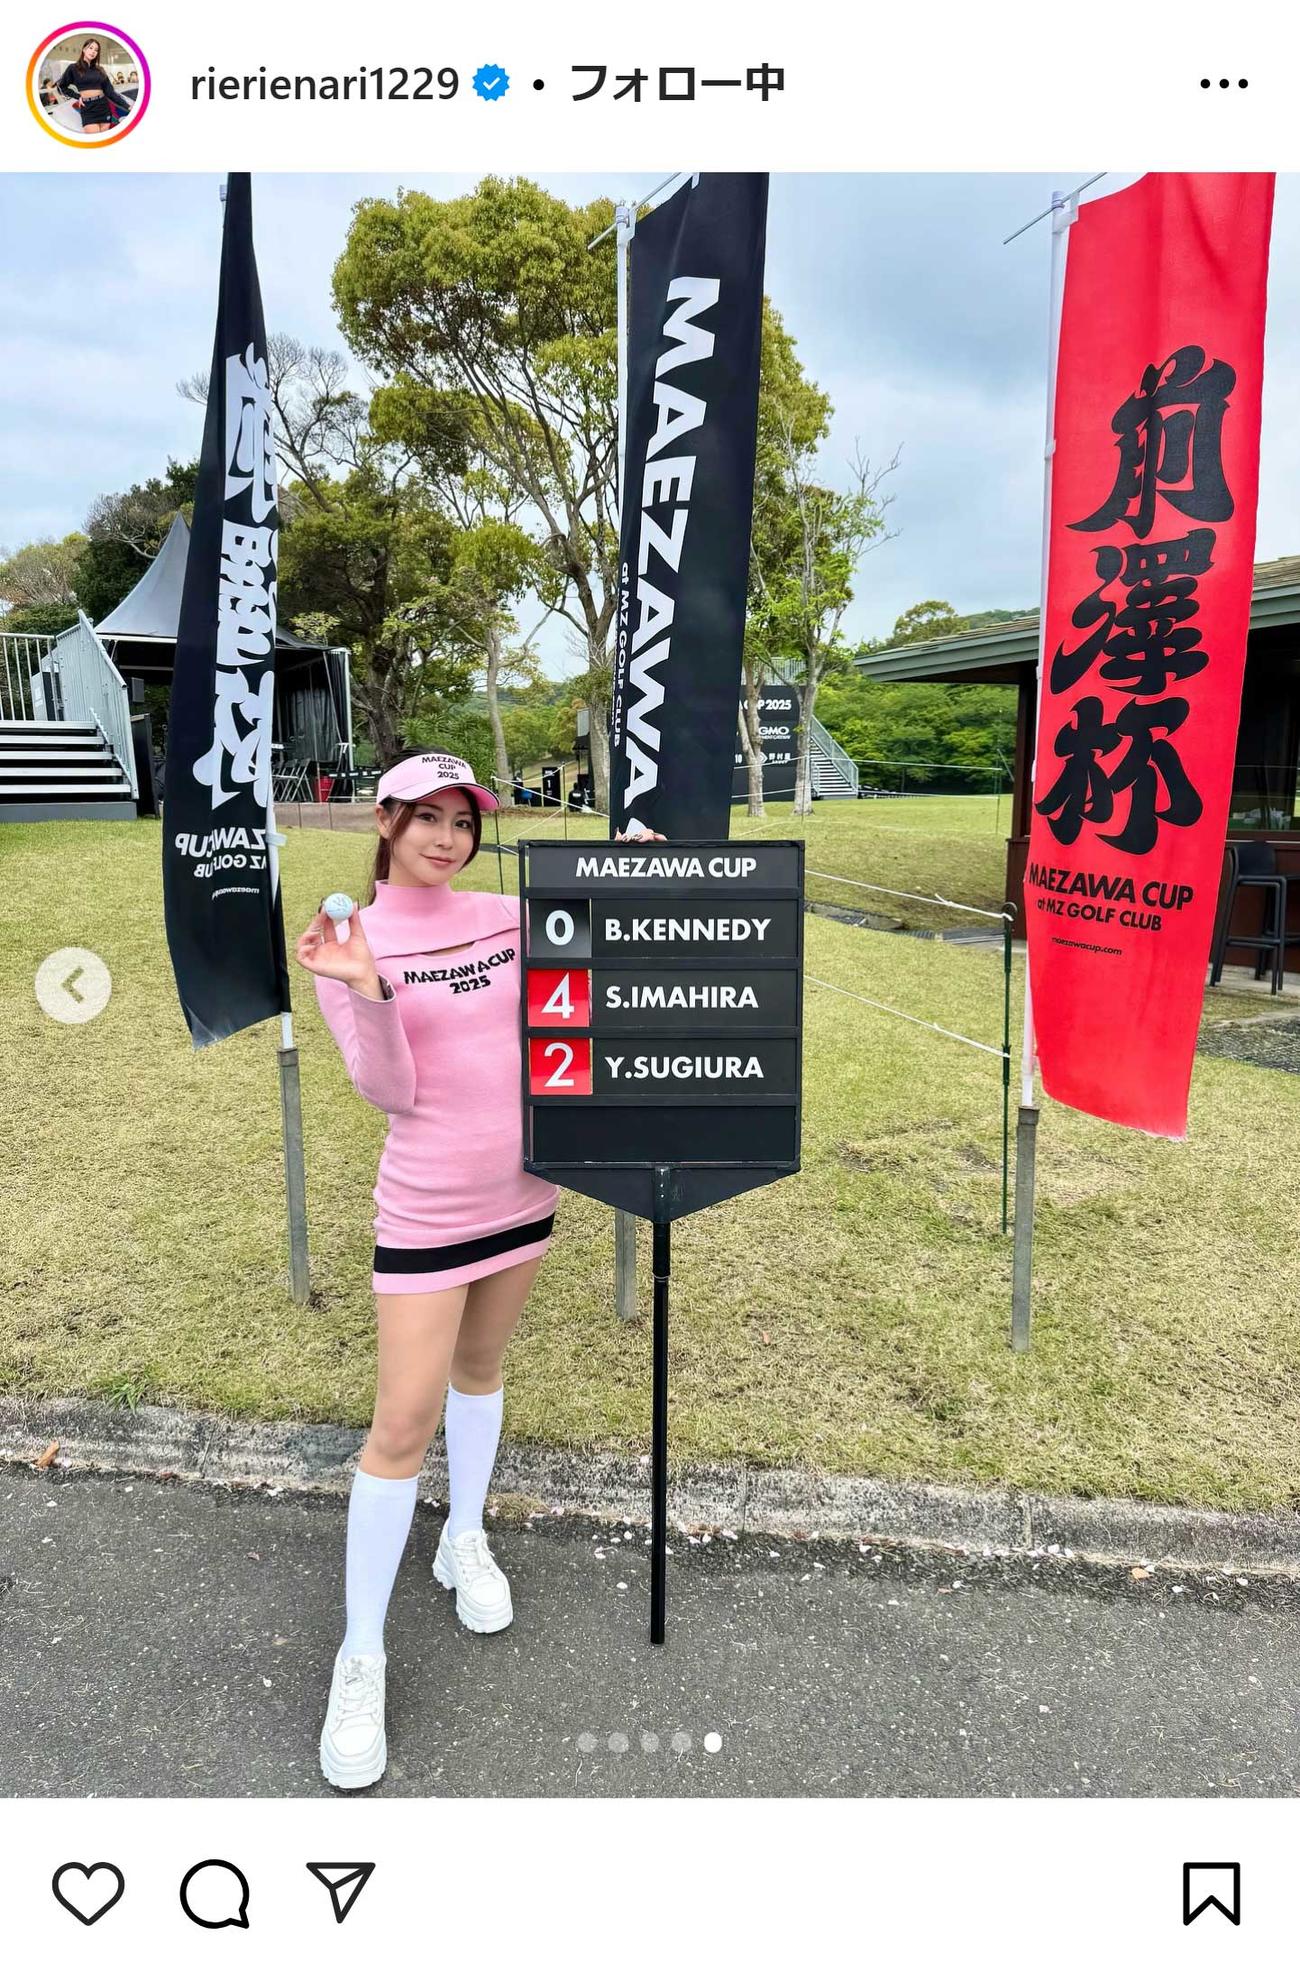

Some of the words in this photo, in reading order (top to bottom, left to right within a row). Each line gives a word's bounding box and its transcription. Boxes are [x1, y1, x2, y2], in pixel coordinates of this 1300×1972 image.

[624, 276, 721, 810] MAEZAWA
[621, 562, 629, 585] at
[619, 590, 630, 627] MZ
[1035, 345, 1237, 855] 前澤杯
[617, 630, 628, 690] GOLF
[614, 695, 622, 747] CLUB
[765, 699, 792, 710] 2025
[758, 726, 790, 736] GMO
[422, 756, 467, 769] MAEZAWA
[437, 771, 460, 780] 2025
[575, 857, 705, 878] MAEZAWA
[708, 857, 757, 878] CUP
[1029, 862, 1136, 904] MAEZAWA
[1142, 881, 1194, 911] CUP
[545, 909, 575, 946] 0
[605, 918, 771, 942] B.KENNEDY
[1037, 900, 1045, 911] at
[1047, 898, 1064, 915] MZ
[1067, 903, 1116, 923] GOLF
[1119, 910, 1163, 931] CLUB
[404, 961, 491, 984] MAEZAWA
[487, 948, 516, 967] CUP
[449, 975, 491, 994] 2025
[541, 971, 575, 1019] 4
[605, 985, 759, 1009] S.IMAHIRA
[543, 1042, 575, 1087] 2
[604, 1056, 764, 1079] Y.SUGIURA
